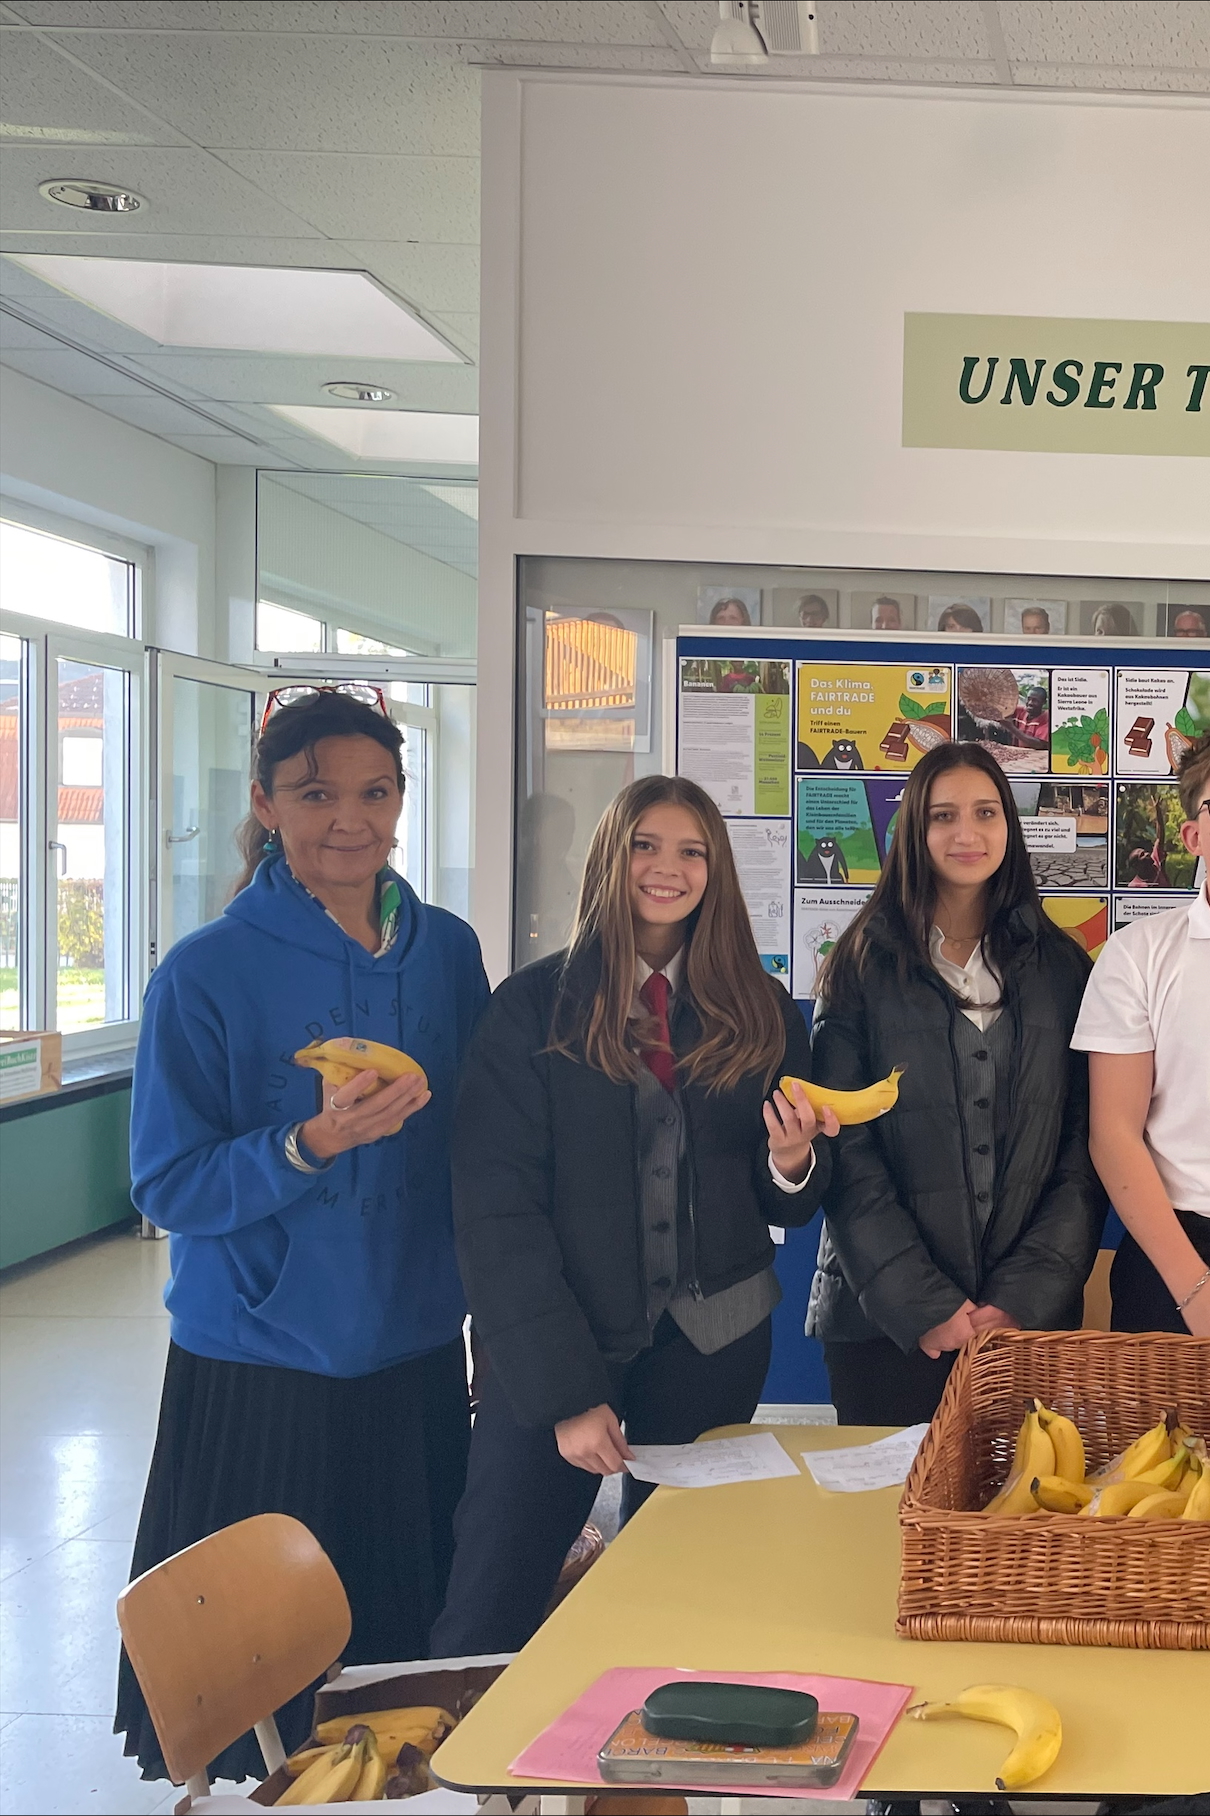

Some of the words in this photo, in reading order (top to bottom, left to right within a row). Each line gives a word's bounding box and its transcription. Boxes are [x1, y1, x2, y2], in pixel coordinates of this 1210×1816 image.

[958, 356, 1165, 410] UNSER
[683, 680, 714, 688] Bananen
[810, 679, 832, 688] Das
[810, 692, 875, 703] FAIRTRADE
[810, 705, 833, 715] und
[836, 706, 851, 715] du
[819, 898, 866, 906] Ausschneide
